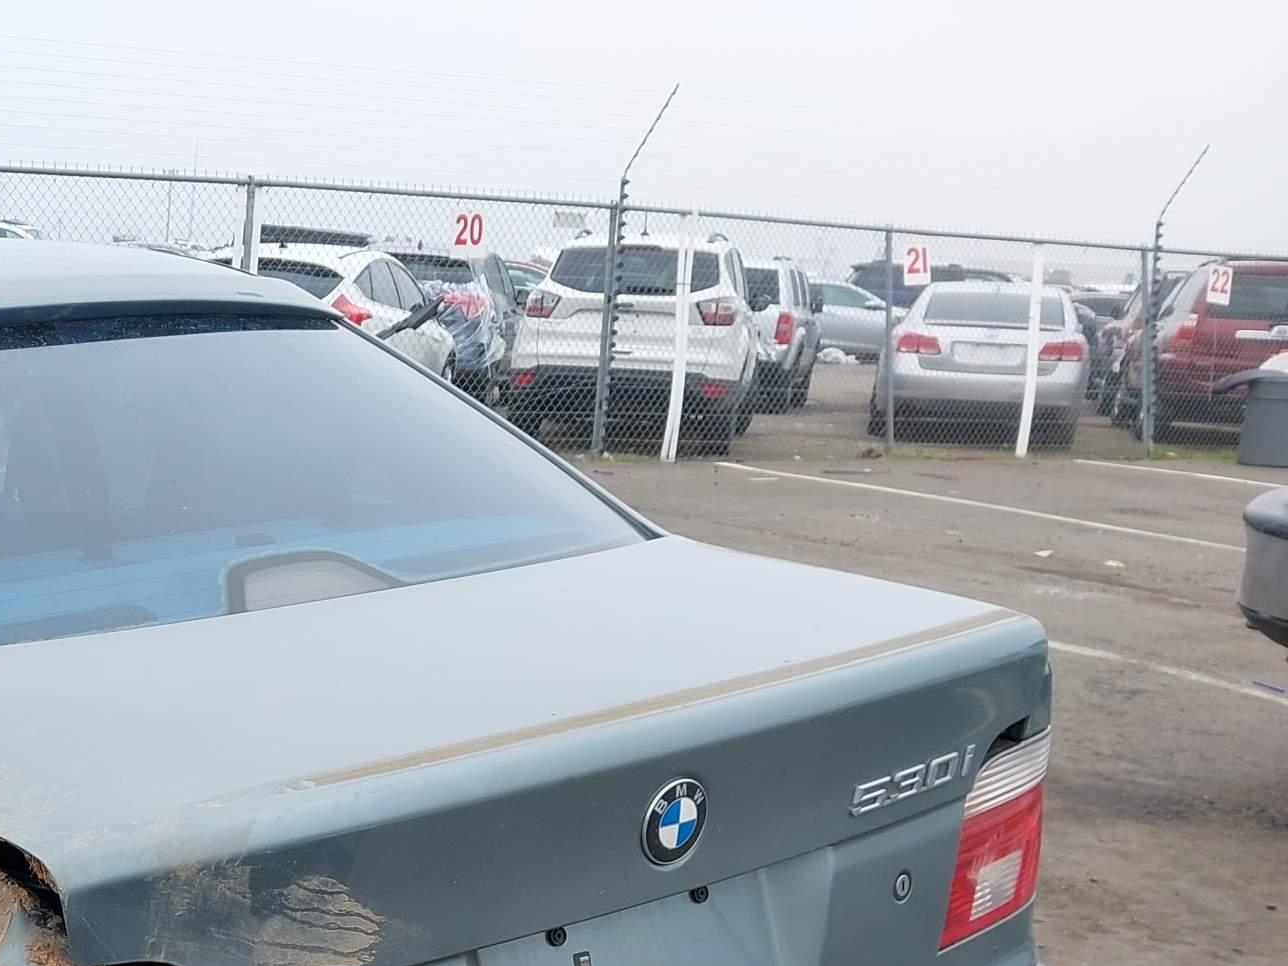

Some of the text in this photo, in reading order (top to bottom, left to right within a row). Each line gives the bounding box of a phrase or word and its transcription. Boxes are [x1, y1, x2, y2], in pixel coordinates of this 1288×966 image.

[454, 213, 483, 246] 20
[906, 247, 928, 274] 21
[1210, 268, 1230, 295] 22
[848, 743, 976, 817] 530i
[654, 783, 705, 815] BMW
